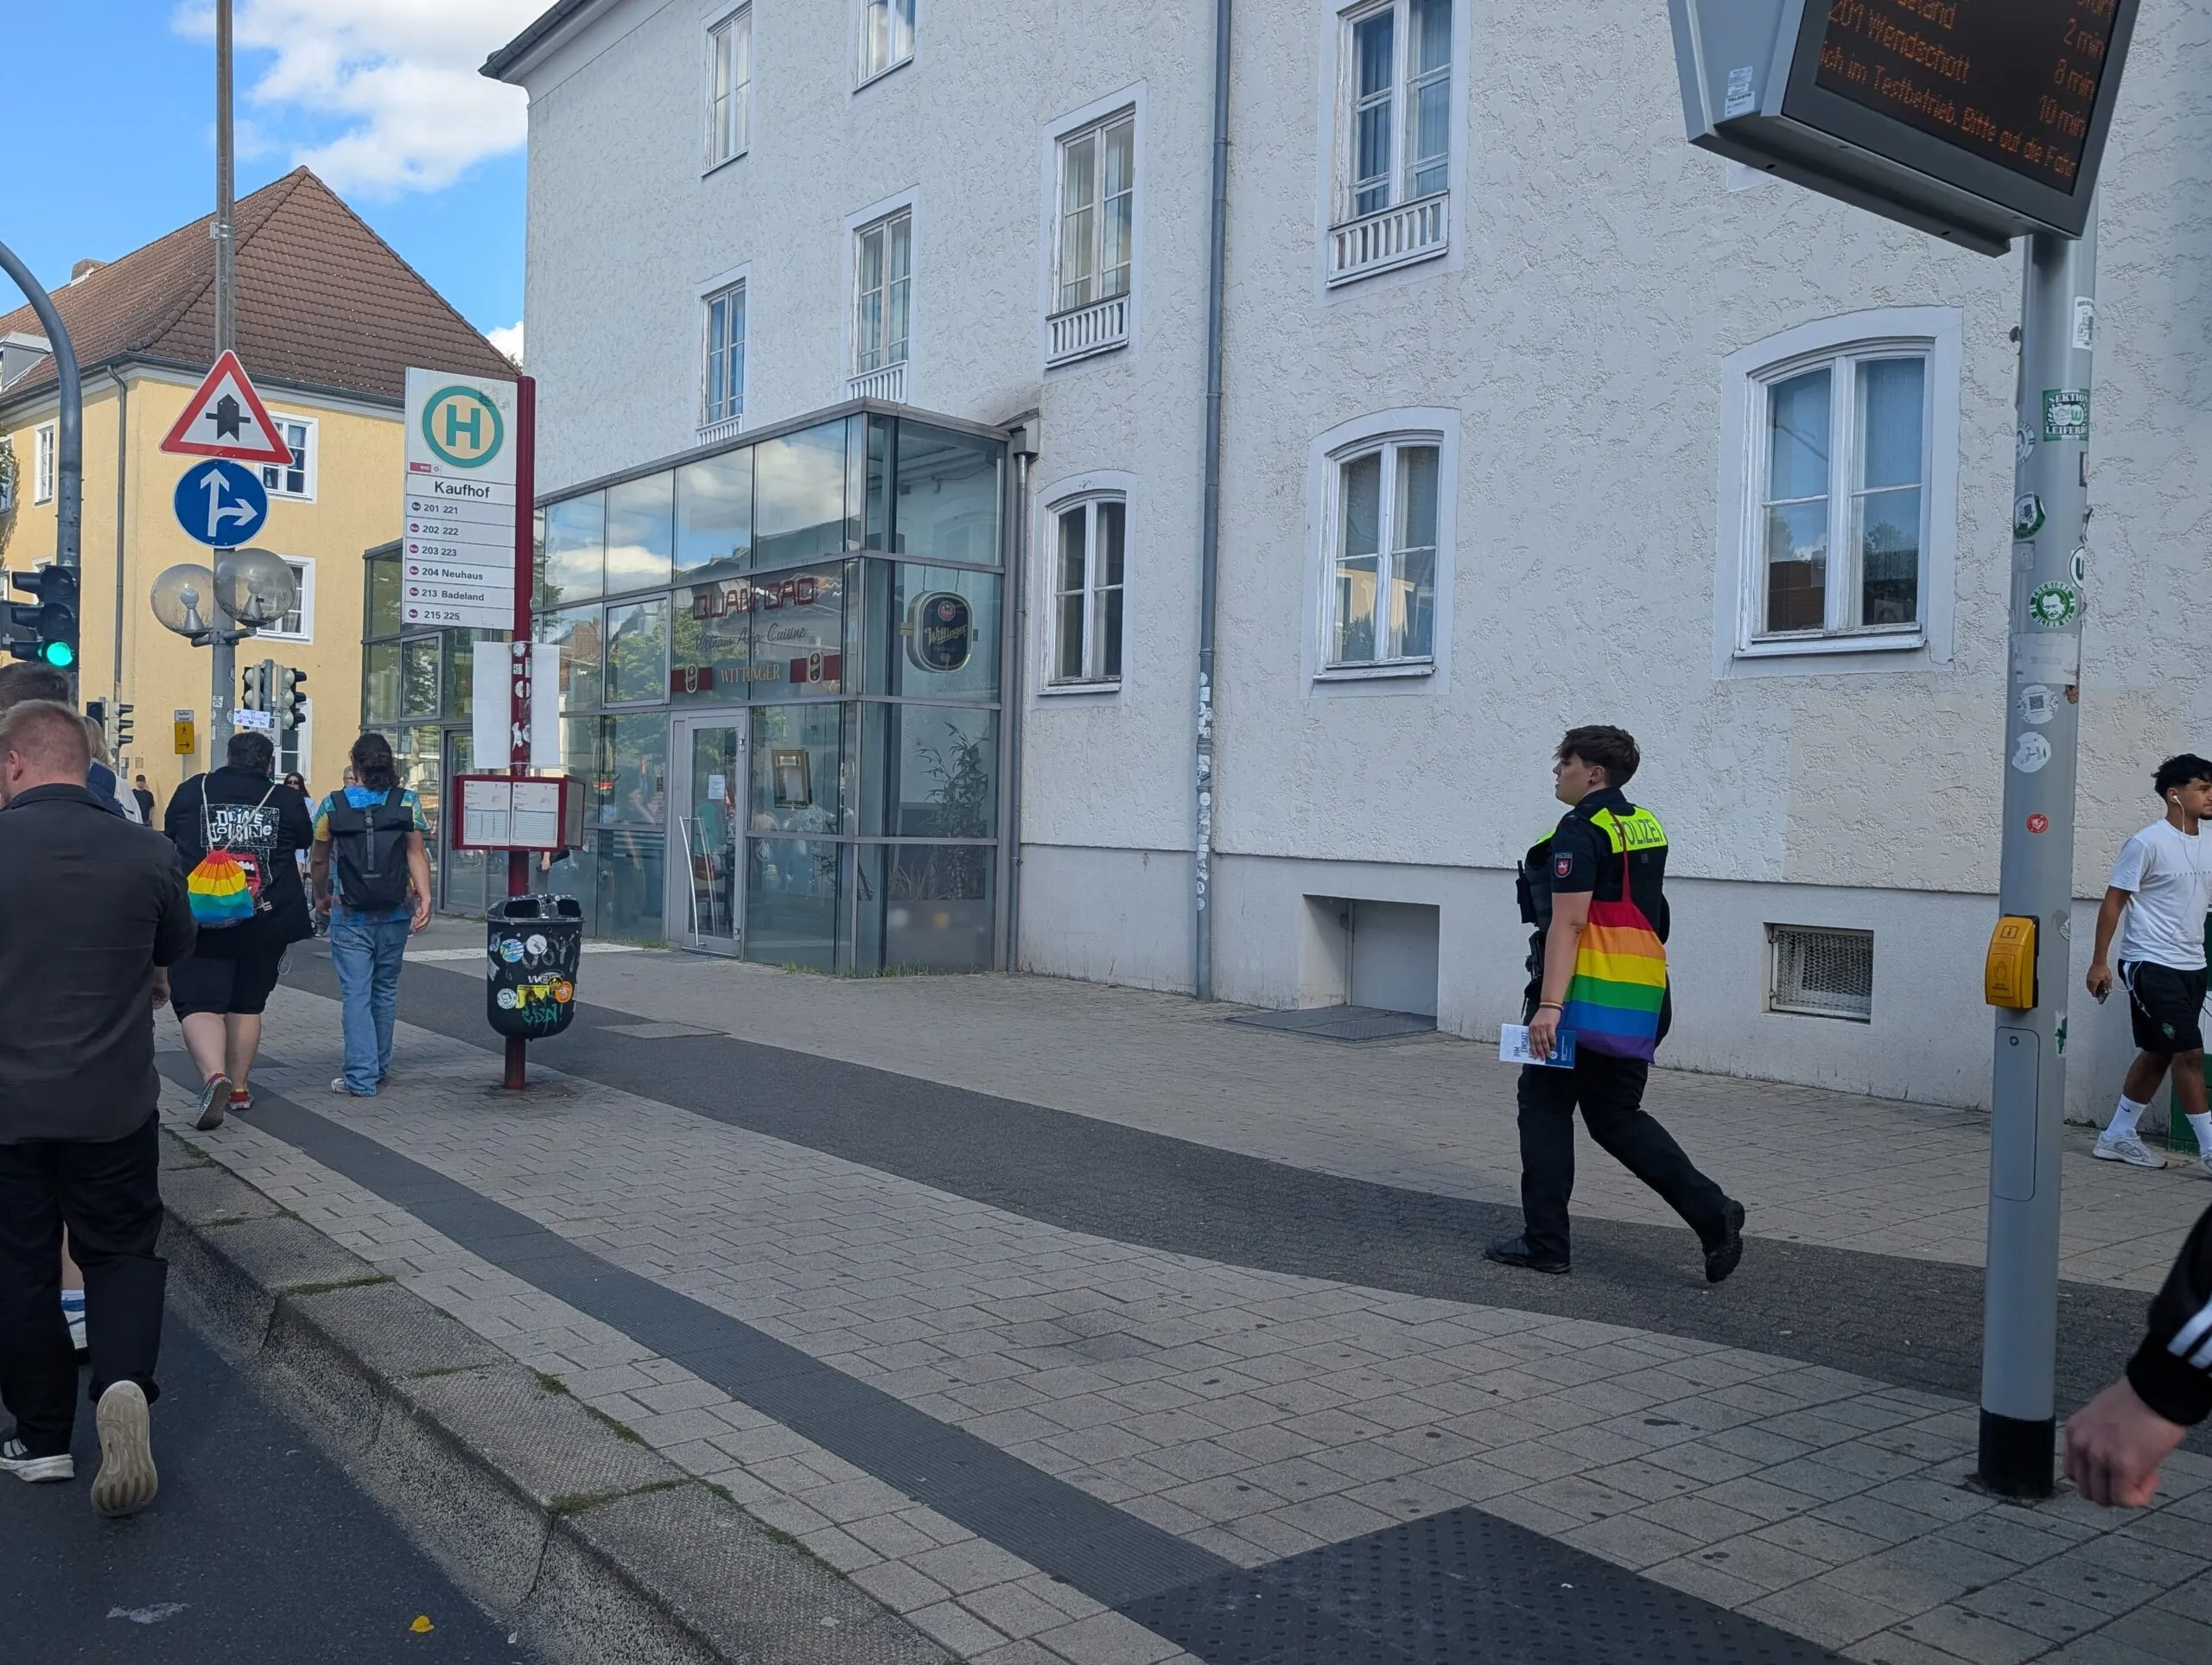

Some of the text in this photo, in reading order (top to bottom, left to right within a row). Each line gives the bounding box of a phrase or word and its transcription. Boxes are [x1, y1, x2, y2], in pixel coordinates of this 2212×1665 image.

[2064, 17, 2105, 60] 2 min
[1828, 0, 2086, 139] 201 Wendschott 10 min
[2054, 58, 2068, 85] 8
[2067, 69, 2095, 100] min
[1847, 54, 1867, 84] im
[1961, 106, 1997, 142] Bitte
[2024, 137, 2044, 163] die
[446, 404, 481, 450] H
[435, 480, 491, 499] Kaufhof
[423, 504, 439, 512] 201
[443, 505, 458, 515] 221
[423, 524, 440, 534] 202
[442, 527, 459, 536] 222
[422, 546, 439, 555] 203
[441, 548, 457, 556] 223
[422, 568, 439, 576] 204
[442, 569, 484, 580] Neuhaus
[422, 588, 437, 597] 213
[442, 590, 485, 601] Badeland
[424, 610, 441, 620] 215
[443, 612, 460, 620] 225
[766, 622, 807, 642] Cuisine
[924, 624, 968, 646] Wittinger
[721, 664, 780, 683] WITTINGER
[1610, 818, 1663, 848] POLIZEI
